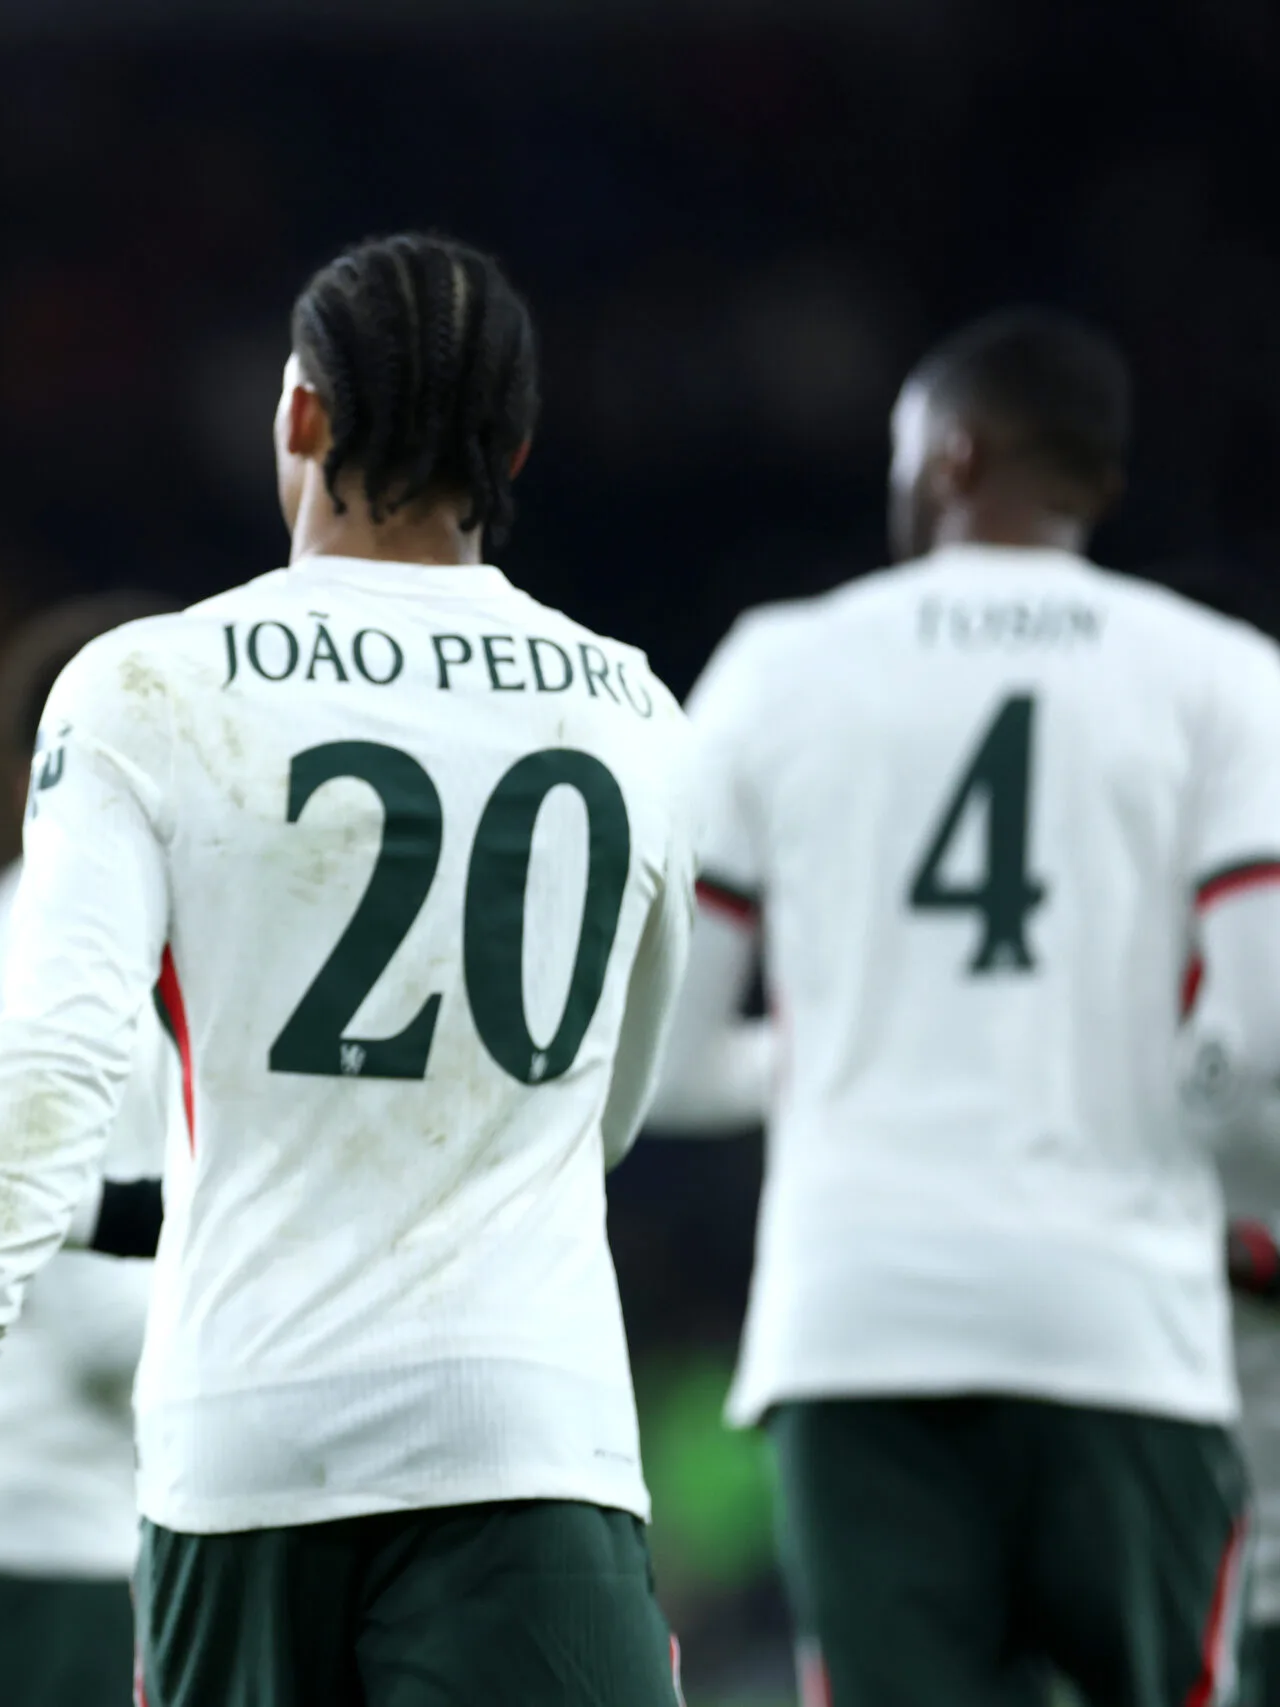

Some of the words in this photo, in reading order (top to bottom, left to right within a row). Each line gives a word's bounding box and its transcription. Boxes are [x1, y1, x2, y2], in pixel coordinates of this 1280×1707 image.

[222, 611, 405, 689] JOÃO
[269, 740, 631, 1086] 20
[907, 689, 1051, 977] 4
